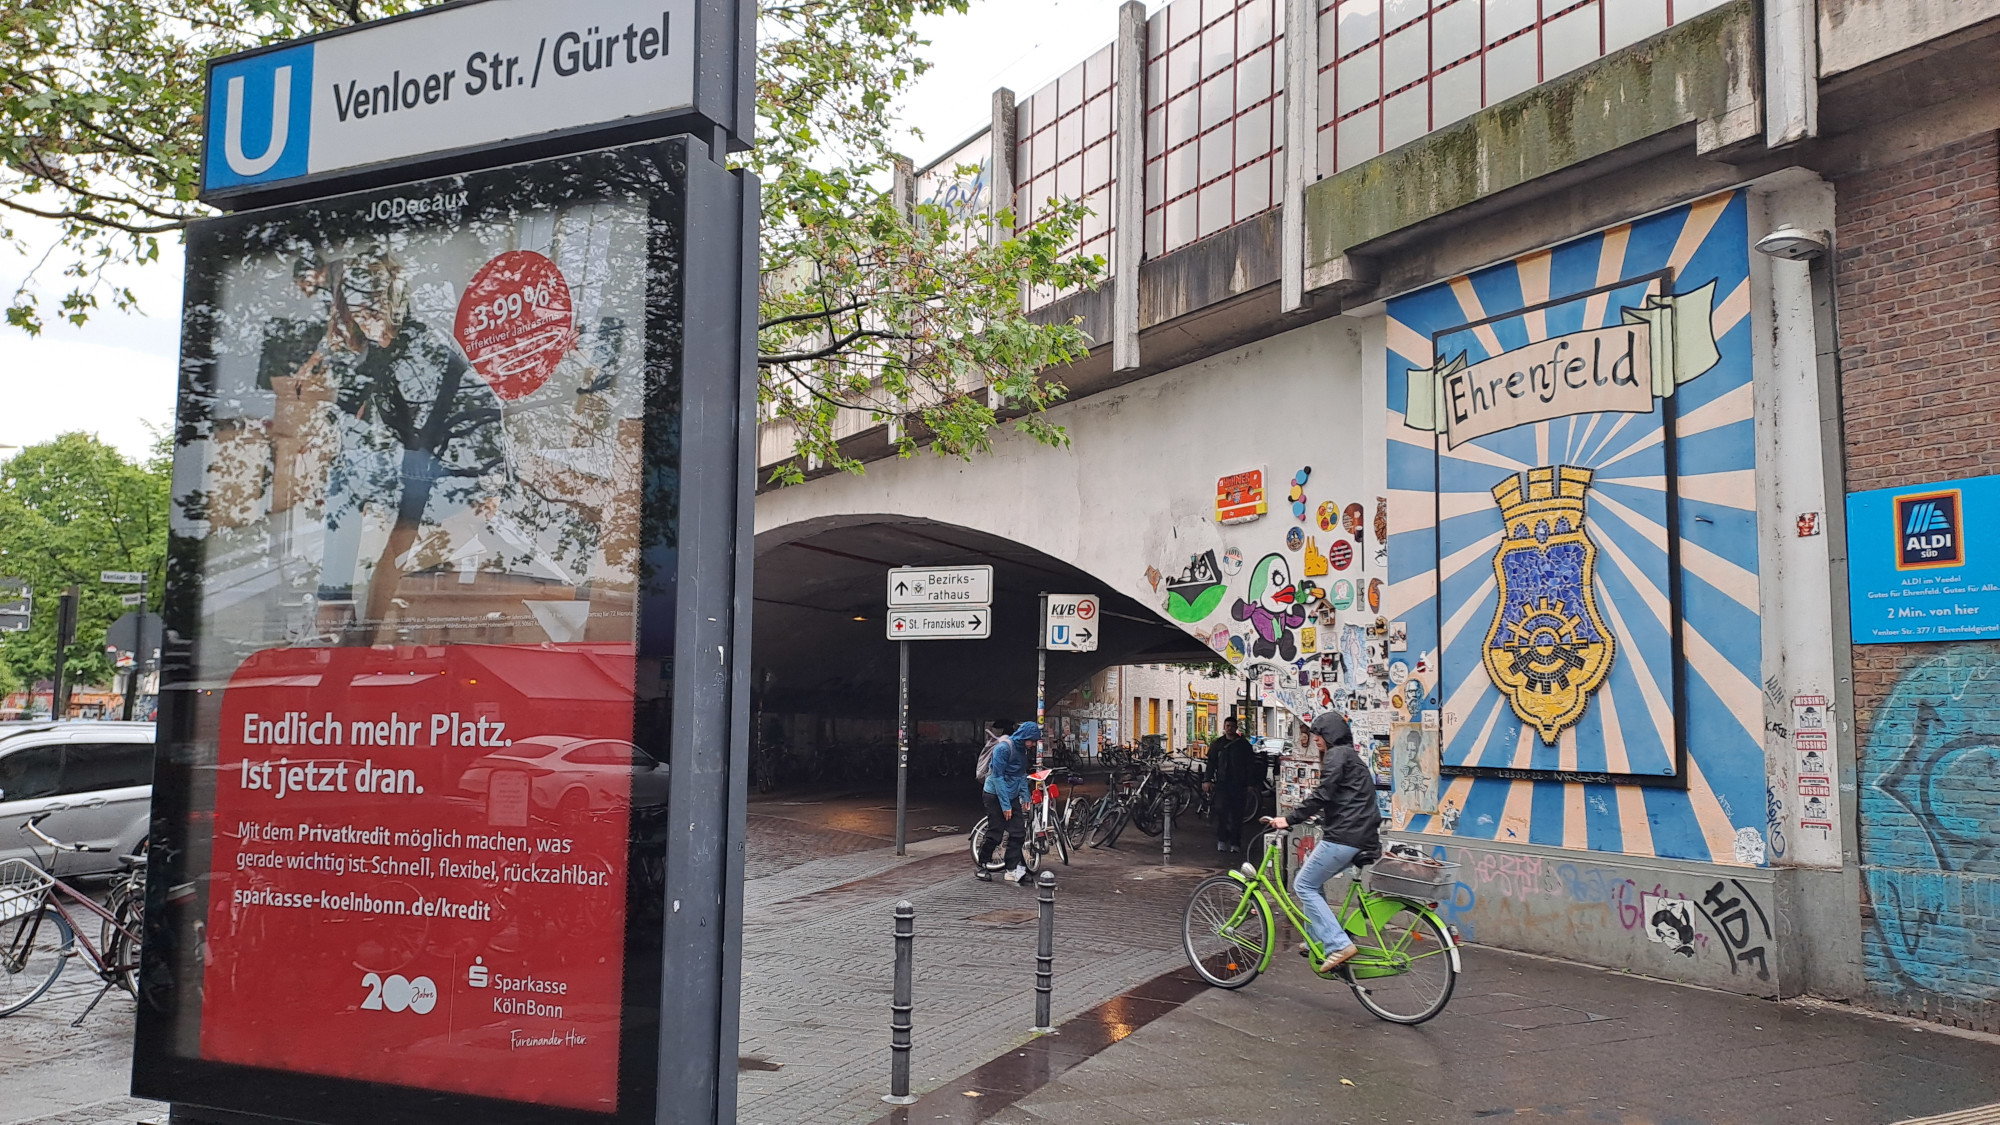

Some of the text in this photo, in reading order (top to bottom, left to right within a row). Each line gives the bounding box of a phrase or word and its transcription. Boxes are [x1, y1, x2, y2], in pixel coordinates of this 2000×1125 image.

[333, 70, 455, 122] Venloer
[465, 52, 524, 95] Str.
[553, 11, 670, 77] Gürtel
[224, 66, 291, 176] U
[365, 190, 469, 223] JCDecaux
[465, 330, 510, 353] effektiver
[1450, 330, 1639, 424] Ehrenfeld
[1906, 533, 1952, 551] ALDI
[1921, 549, 1938, 558] SÜD
[928, 574, 975, 585] Bezirks-
[1901, 577, 1921, 586] ALDI
[928, 589, 970, 601] rathaus
[1867, 590, 1889, 599] Gutes
[1943, 585, 1966, 594] Gutes
[1051, 604, 1076, 616] KVB
[1887, 604, 1980, 619] 2 Min. von hier
[909, 618, 965, 630] St. Franziskus
[1917, 625, 1930, 634] 377
[1053, 626, 1068, 643] U
[1795, 696, 1825, 706] MISSING
[243, 712, 513, 747] Endlich mehr Platz.
[1797, 740, 1827, 750] MISSING
[241, 757, 424, 799] Ist jetzt dran.
[1800, 786, 1830, 796] MISSING
[238, 821, 572, 854] Mit dem Privatkredit möglich machen, was
[236, 850, 609, 887] gerade wichtig ist. Schnell, flexibel, rückzahlbar.
[234, 886, 491, 921] sparkasse-koelnbonn.de/kredit
[360, 972, 437, 1015] 200
[494, 973, 568, 995] Sparkasse
[493, 997, 563, 1018] KölnBonn
[510, 1028, 563, 1051] Füreinander
